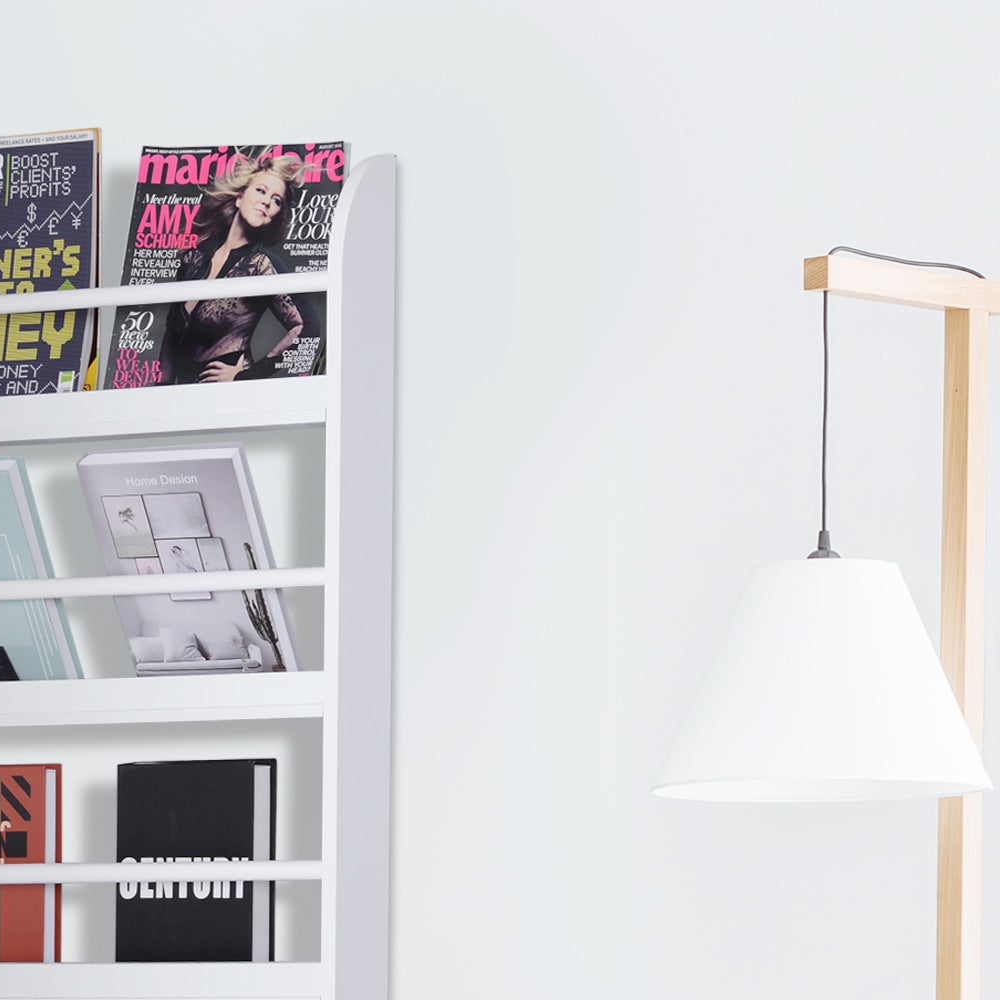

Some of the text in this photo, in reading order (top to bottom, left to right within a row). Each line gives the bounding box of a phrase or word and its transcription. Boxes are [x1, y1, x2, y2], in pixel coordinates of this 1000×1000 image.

[11, 152, 59, 170] BOOST
[256, 144, 345, 182] ire
[10, 181, 71, 199] PROFITS
[142, 193, 204, 205] Meet the real
[296, 189, 339, 208] Love
[137, 204, 201, 234] AMY
[135, 232, 199, 249] SCHUMER
[133, 249, 179, 259] HER MOST
[132, 258, 182, 268] REVEALING
[130, 268, 178, 278] INTERVIEW
[120, 311, 154, 331] 50
[119, 329, 149, 341] new
[300, 336, 320, 344] YOUR
[118, 339, 155, 354] ways
[282, 349, 316, 357] CONTROL
[117, 348, 138, 360] TO
[282, 355, 315, 363] MESSING
[116, 359, 162, 372] WEAR
[113, 370, 163, 384] DENIM
[6, 380, 39, 395] AND
[125, 473, 199, 487] Home Design
